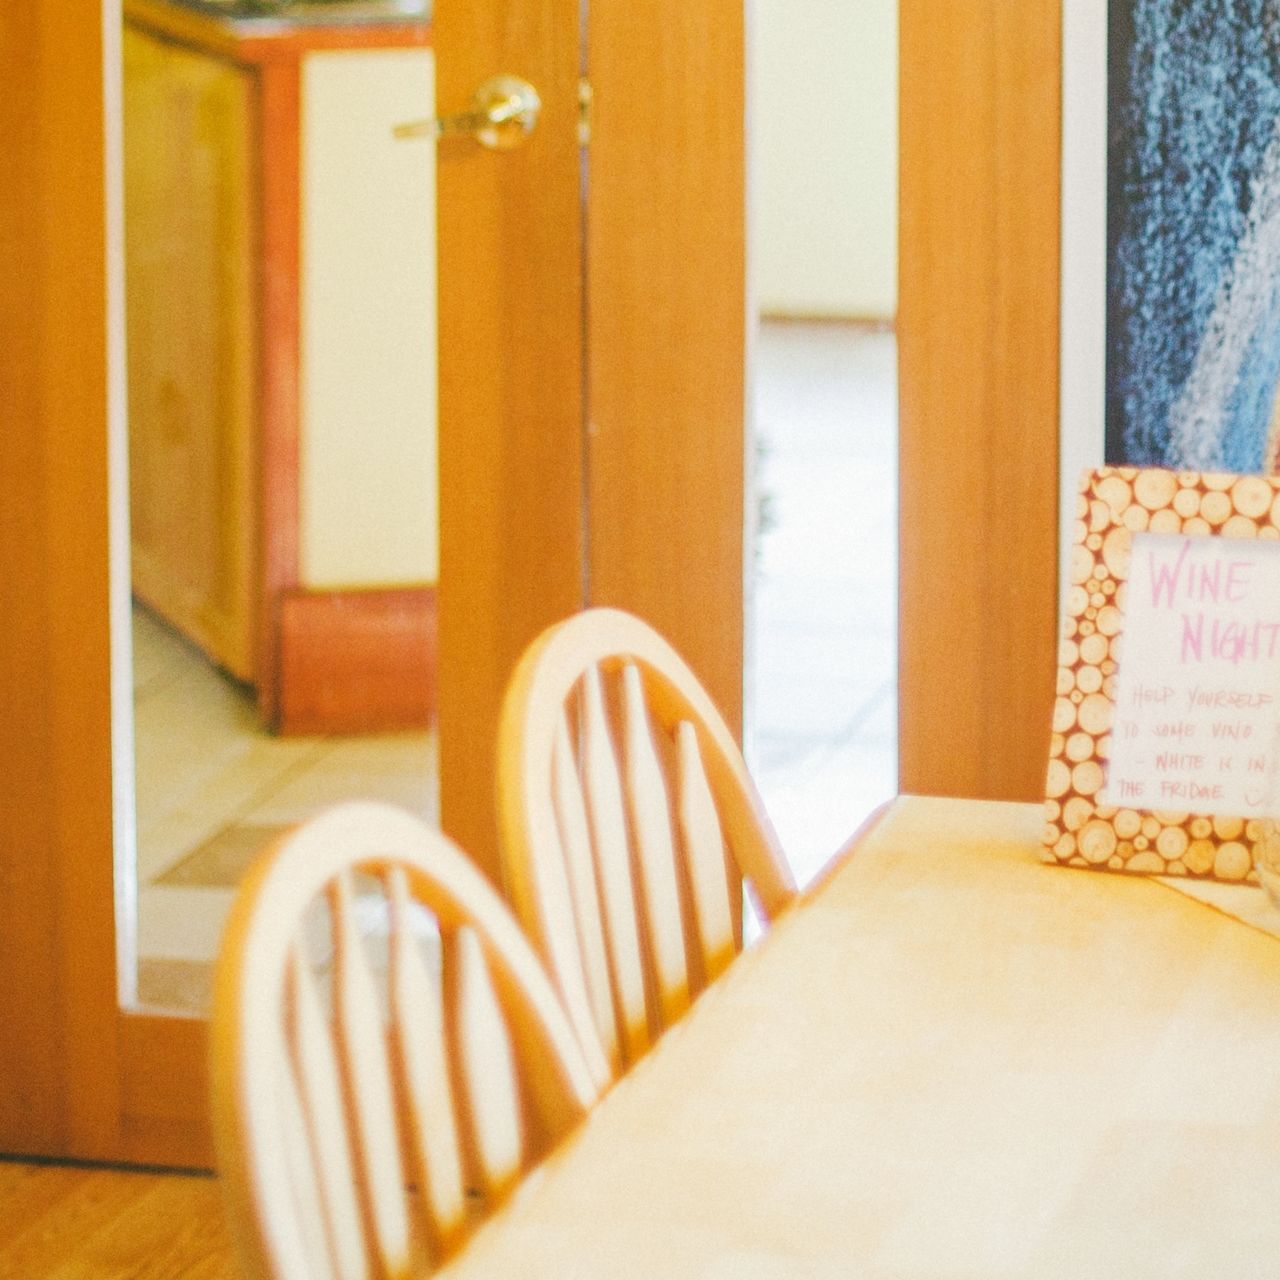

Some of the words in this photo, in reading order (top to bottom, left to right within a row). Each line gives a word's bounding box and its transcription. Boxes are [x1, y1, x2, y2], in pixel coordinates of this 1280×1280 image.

[1148, 539, 1254, 609] WINE
[1132, 684, 1175, 708] HELP
[1187, 685, 1273, 711] YOURSELF
[1247, 753, 1266, 771] IN
